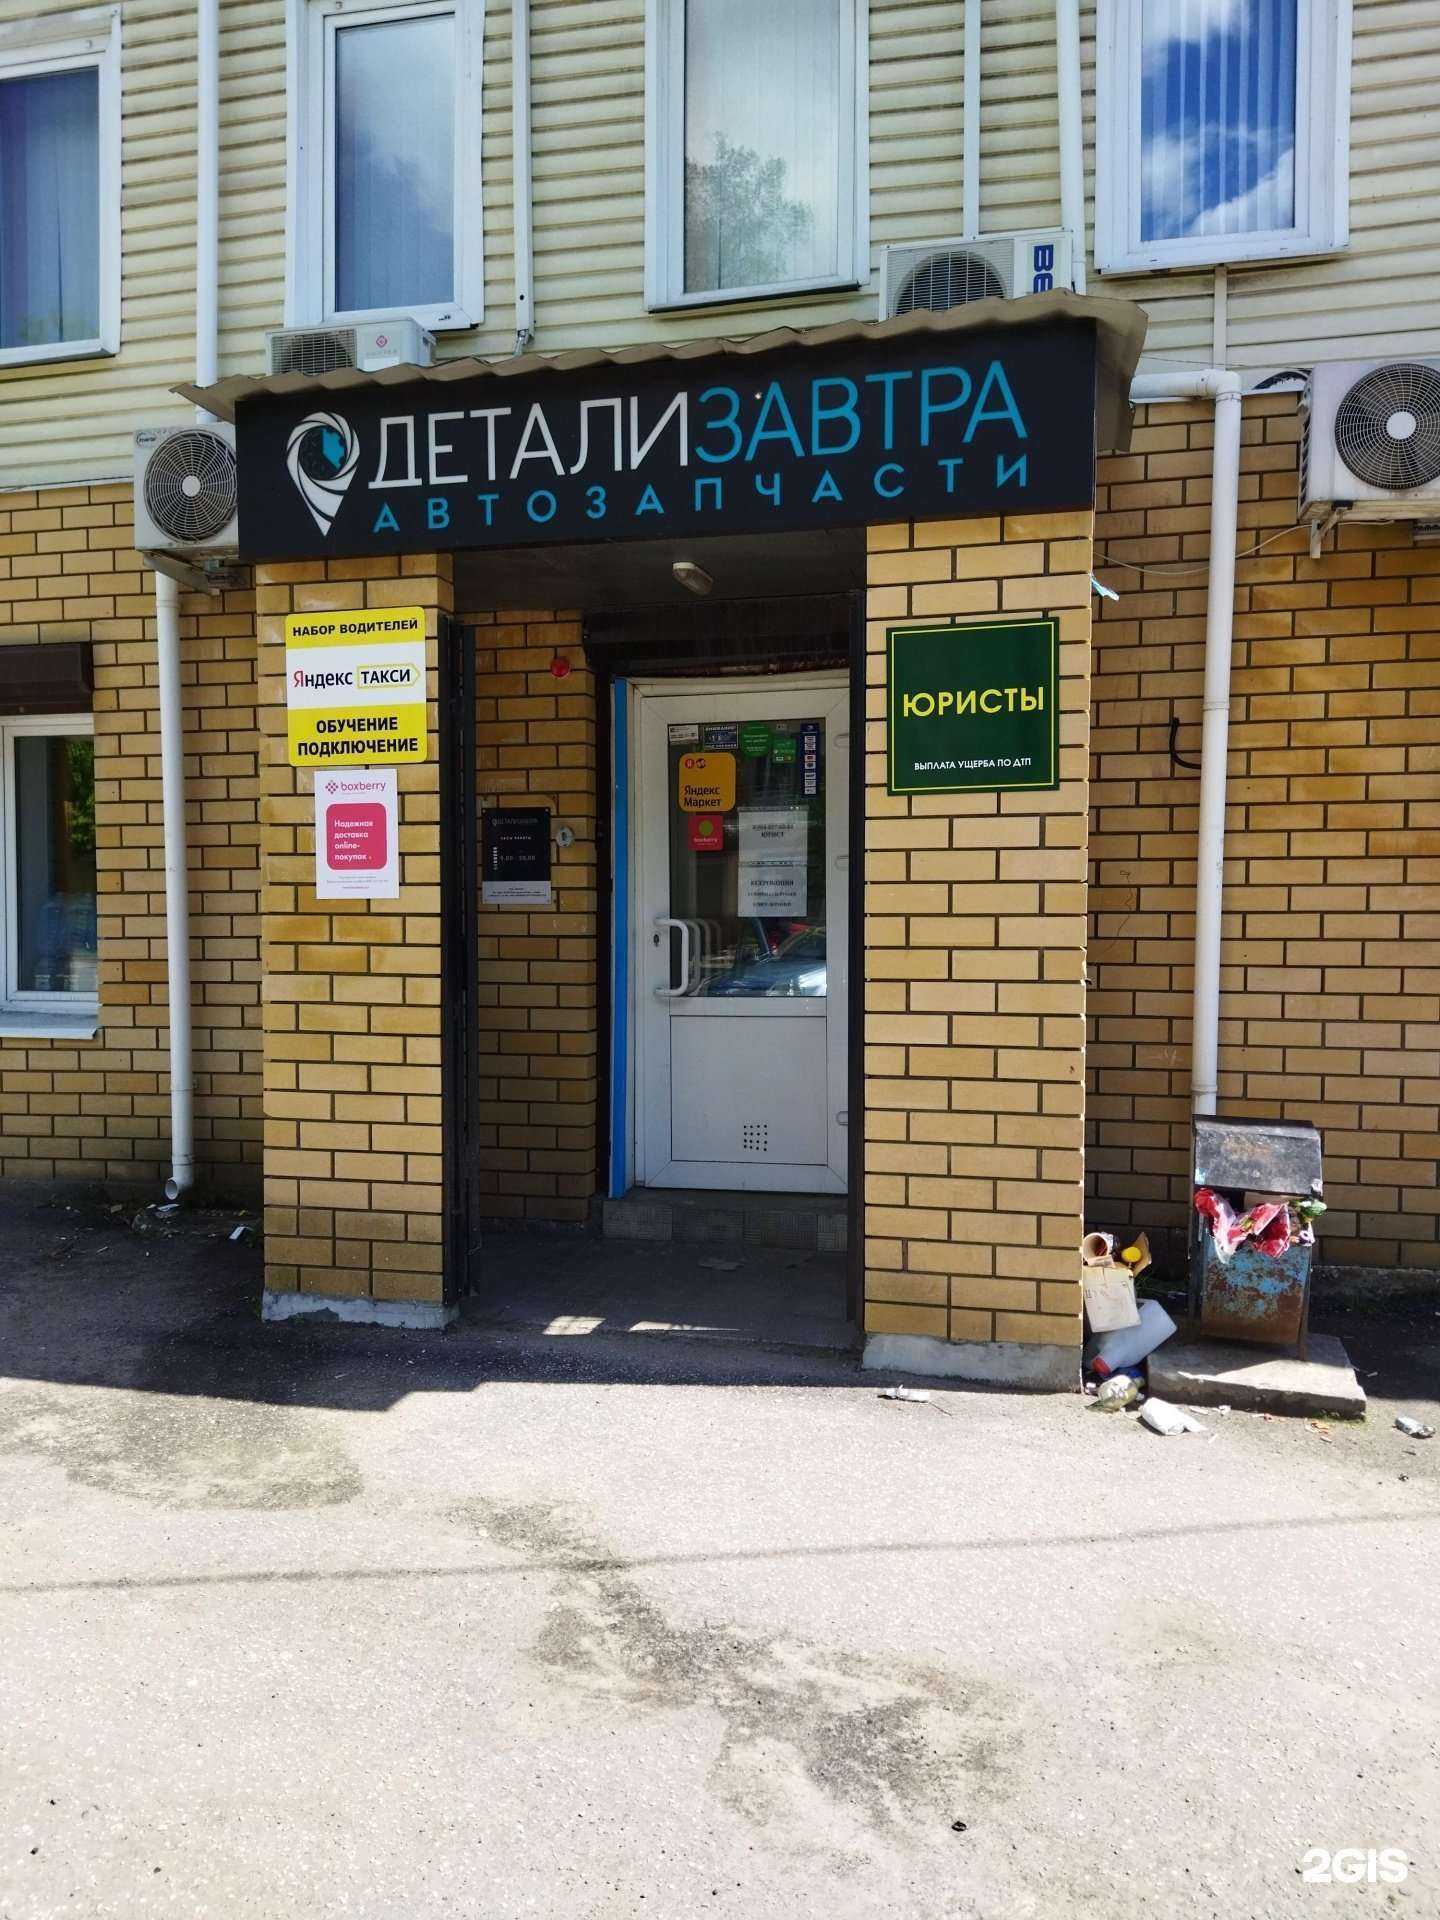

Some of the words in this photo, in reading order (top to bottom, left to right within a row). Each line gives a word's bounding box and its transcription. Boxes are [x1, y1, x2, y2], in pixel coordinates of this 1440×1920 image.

[372, 454, 1028, 533] АВТОЗАПЧАСТИ
[293, 625, 335, 637] НАБОР
[340, 618, 418, 634] ВОДИТЕЛЕЙ
[293, 670, 353, 689] Яндекс
[361, 669, 410, 684] ТАКСИ
[903, 687, 1044, 717] ЮРИСТЫ
[316, 717, 398, 734] ОБУЧЕНИЕ
[298, 738, 418, 757] ПОДКЛЮЧЕНИЕ
[914, 761, 956, 771] ВЫПЛАТА
[958, 759, 996, 770] УЩЕРБА
[997, 759, 1011, 768] ПО
[1012, 757, 1032, 768] ДТП
[340, 781, 386, 792] boxberry
[684, 785, 721, 795] Яндекс
[683, 797, 722, 808] Маркет
[334, 832, 369, 840] доставка
